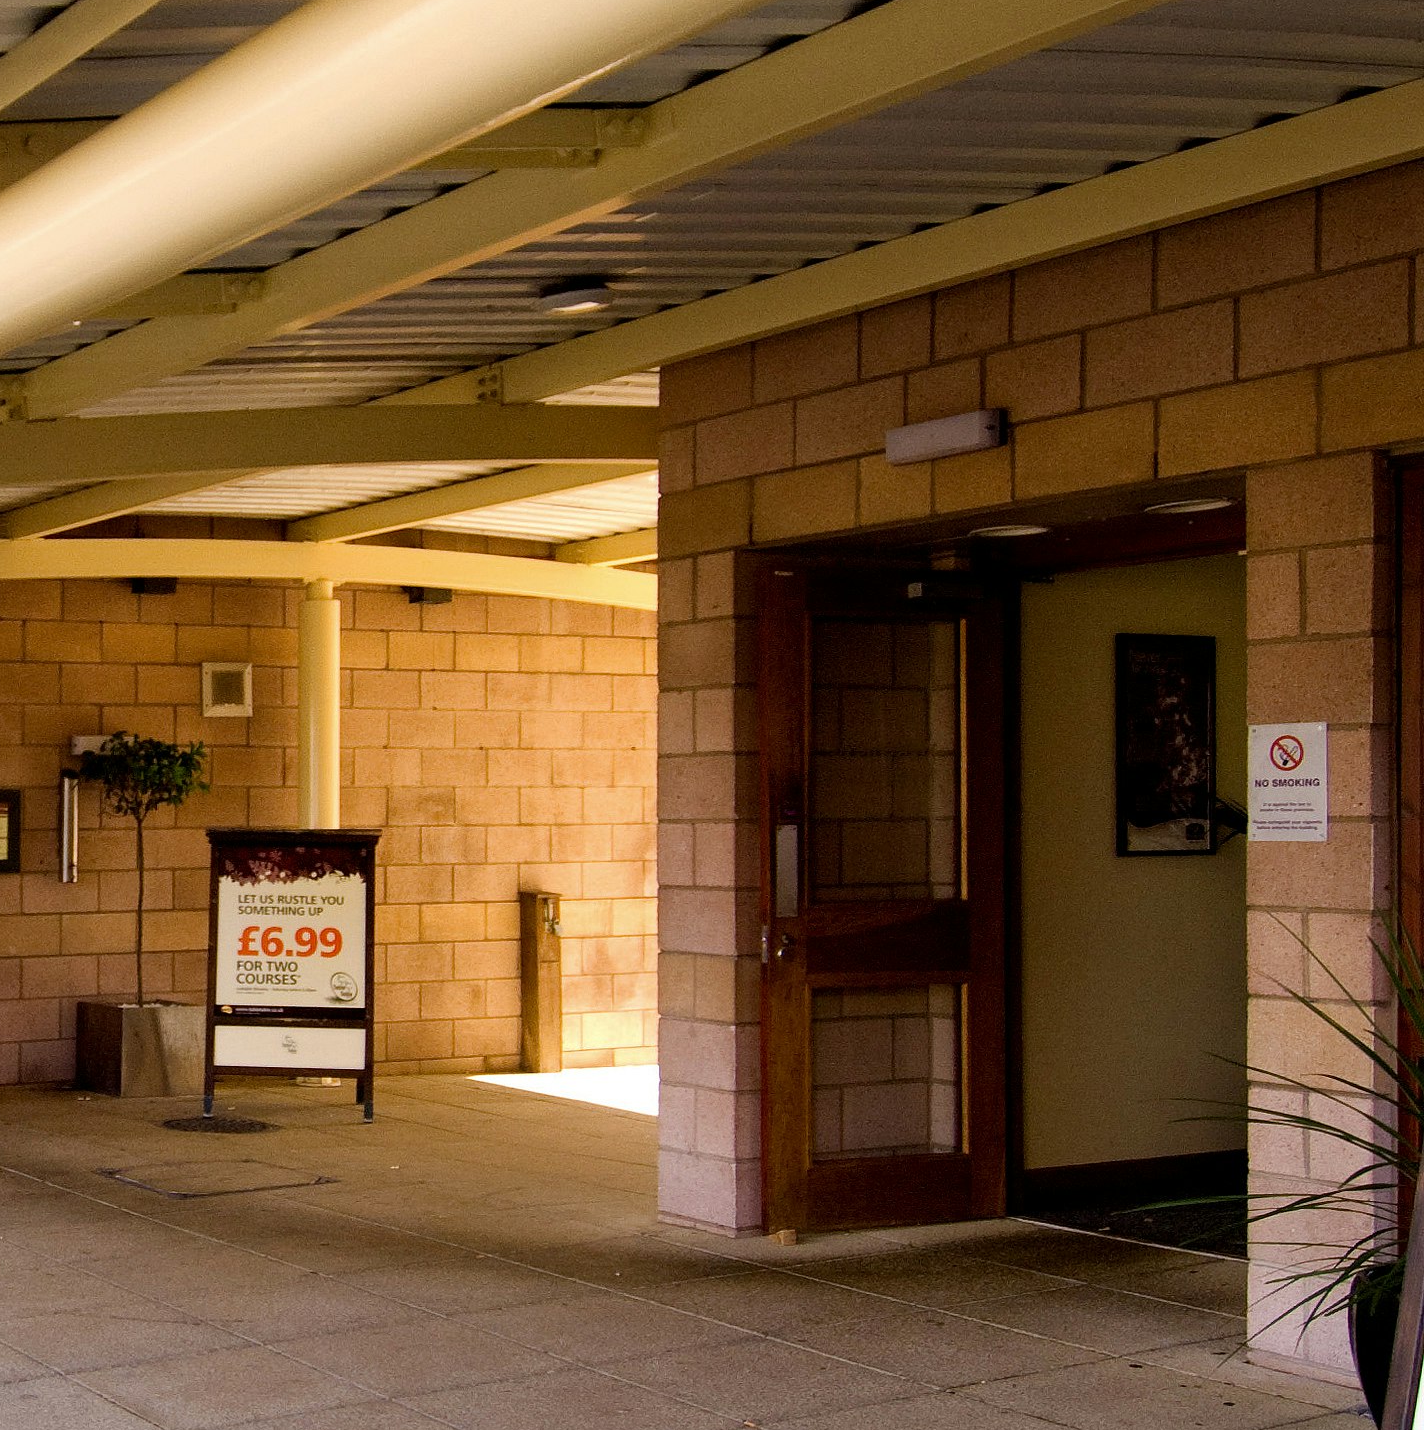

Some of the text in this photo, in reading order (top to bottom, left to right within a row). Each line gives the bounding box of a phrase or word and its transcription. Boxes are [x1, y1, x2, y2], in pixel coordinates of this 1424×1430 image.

[1255, 778, 1320, 787] NO SMOKING
[238, 895, 345, 906] LET US RUSTLE YOU
[238, 906, 324, 916] SOMETHING UP
[237, 925, 343, 958] £6.99
[236, 960, 298, 972] FOR TWO
